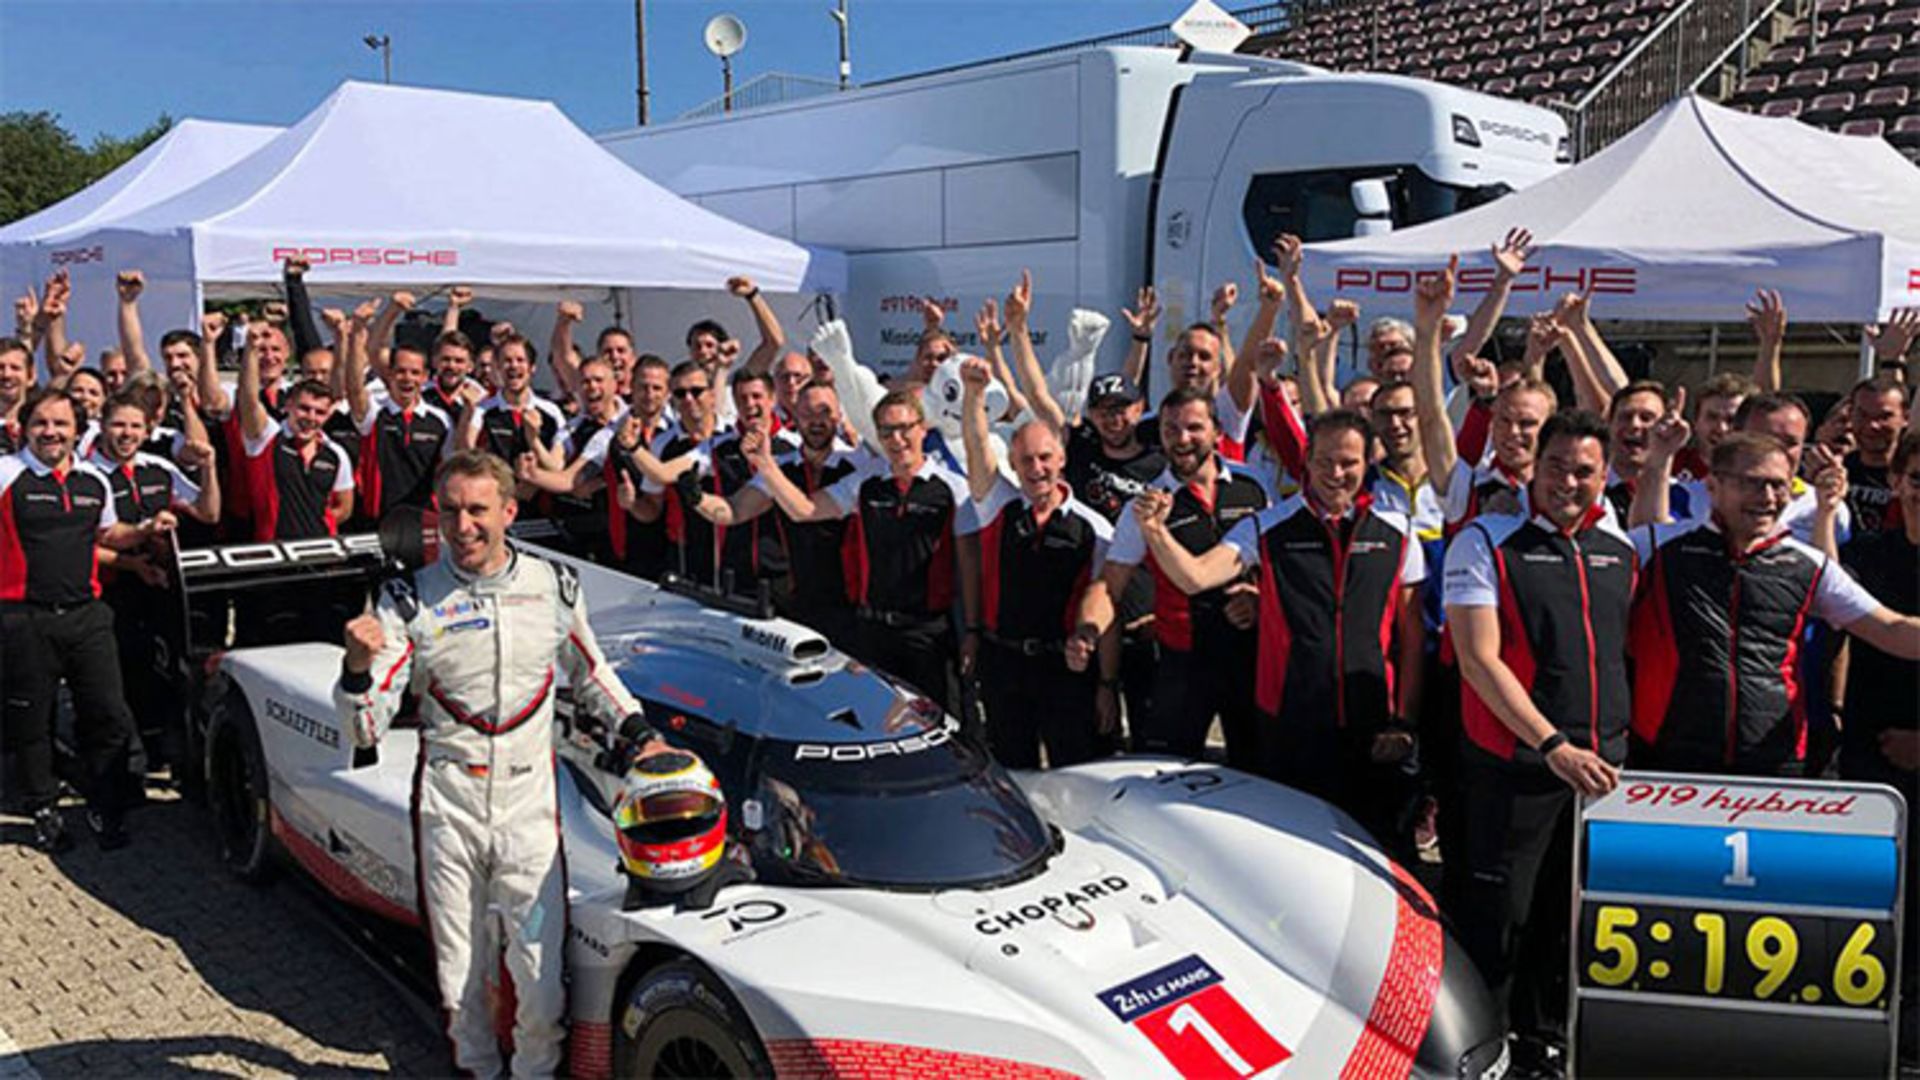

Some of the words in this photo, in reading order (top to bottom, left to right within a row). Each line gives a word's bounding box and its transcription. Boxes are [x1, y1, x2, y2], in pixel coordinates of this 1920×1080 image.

[1479, 120, 1551, 146] PORSCHE
[272, 247, 459, 266] PORSCHE
[179, 533, 384, 567] PORS
[265, 698, 340, 750] SCHAEFFLER
[1625, 783, 1699, 806] 919
[1701, 788, 1858, 822] hybrid
[1723, 831, 1756, 887] 1
[975, 875, 1130, 936] CHOPARD
[1588, 906, 1886, 1005] 5:19.6
[1166, 966, 1212, 993] MANS
[1167, 1002, 1255, 1077] 1
